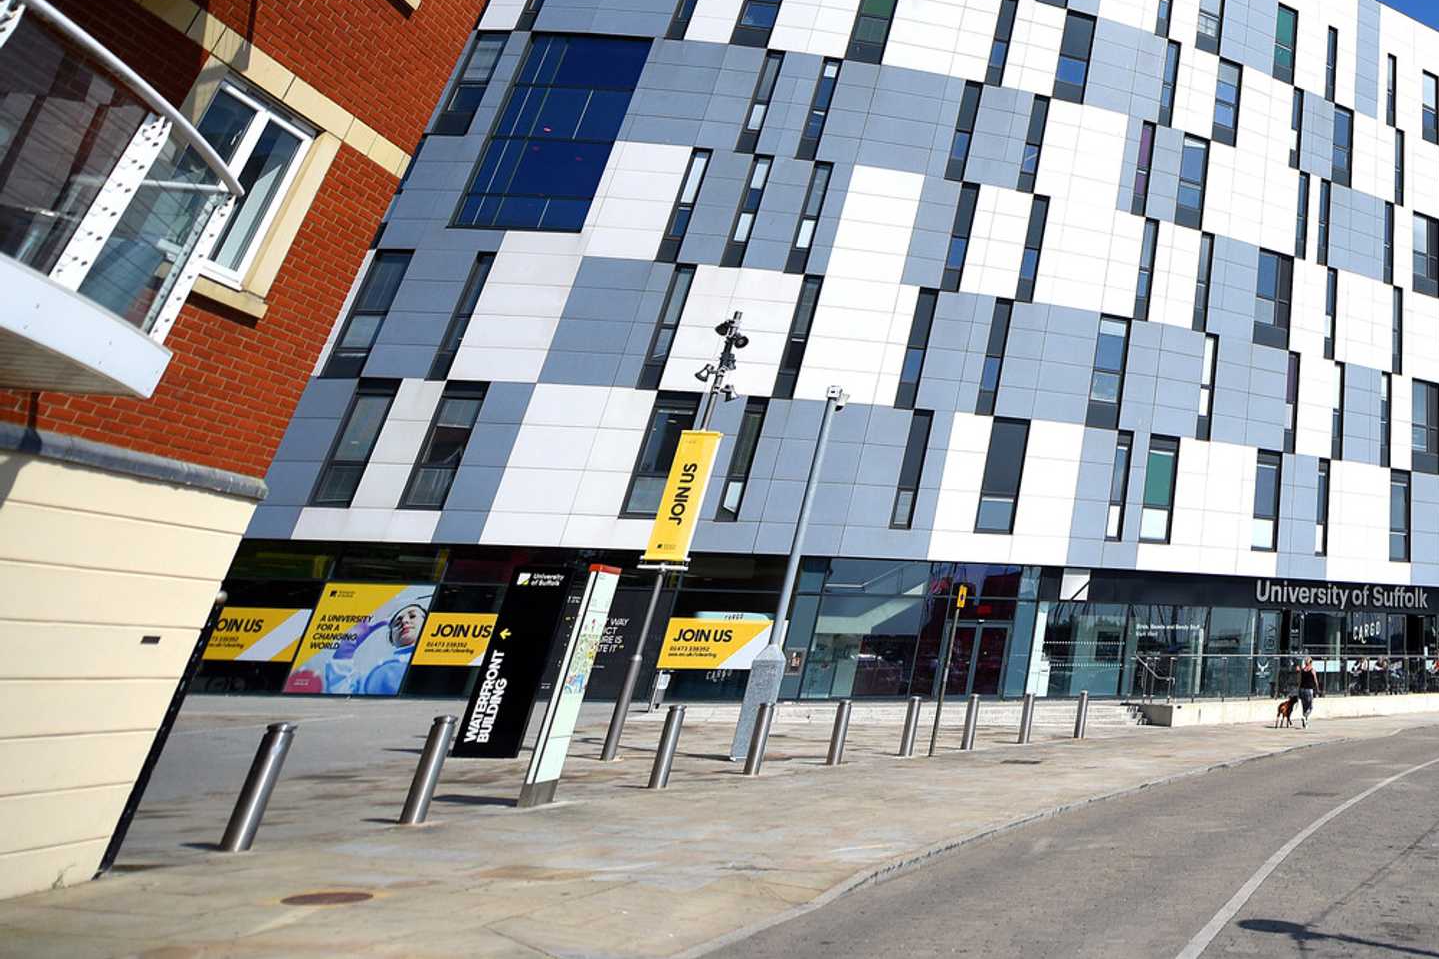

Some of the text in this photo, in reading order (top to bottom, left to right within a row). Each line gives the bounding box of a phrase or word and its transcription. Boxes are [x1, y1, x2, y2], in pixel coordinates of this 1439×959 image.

[668, 487, 692, 526] JOIN
[680, 463, 698, 483] US
[1256, 579, 1428, 609] University of Suffolk
[215, 618, 264, 633] OIN US
[327, 615, 374, 623] UNIVERSITY
[312, 633, 358, 641] CHANGING
[430, 624, 494, 638] JOIN US
[673, 629, 733, 642] JOIN US
[1353, 621, 1381, 644] CARGO
[310, 642, 340, 650] WORLD
[463, 649, 505, 743] WATERFRONT
[477, 678, 508, 743] BUILDING
